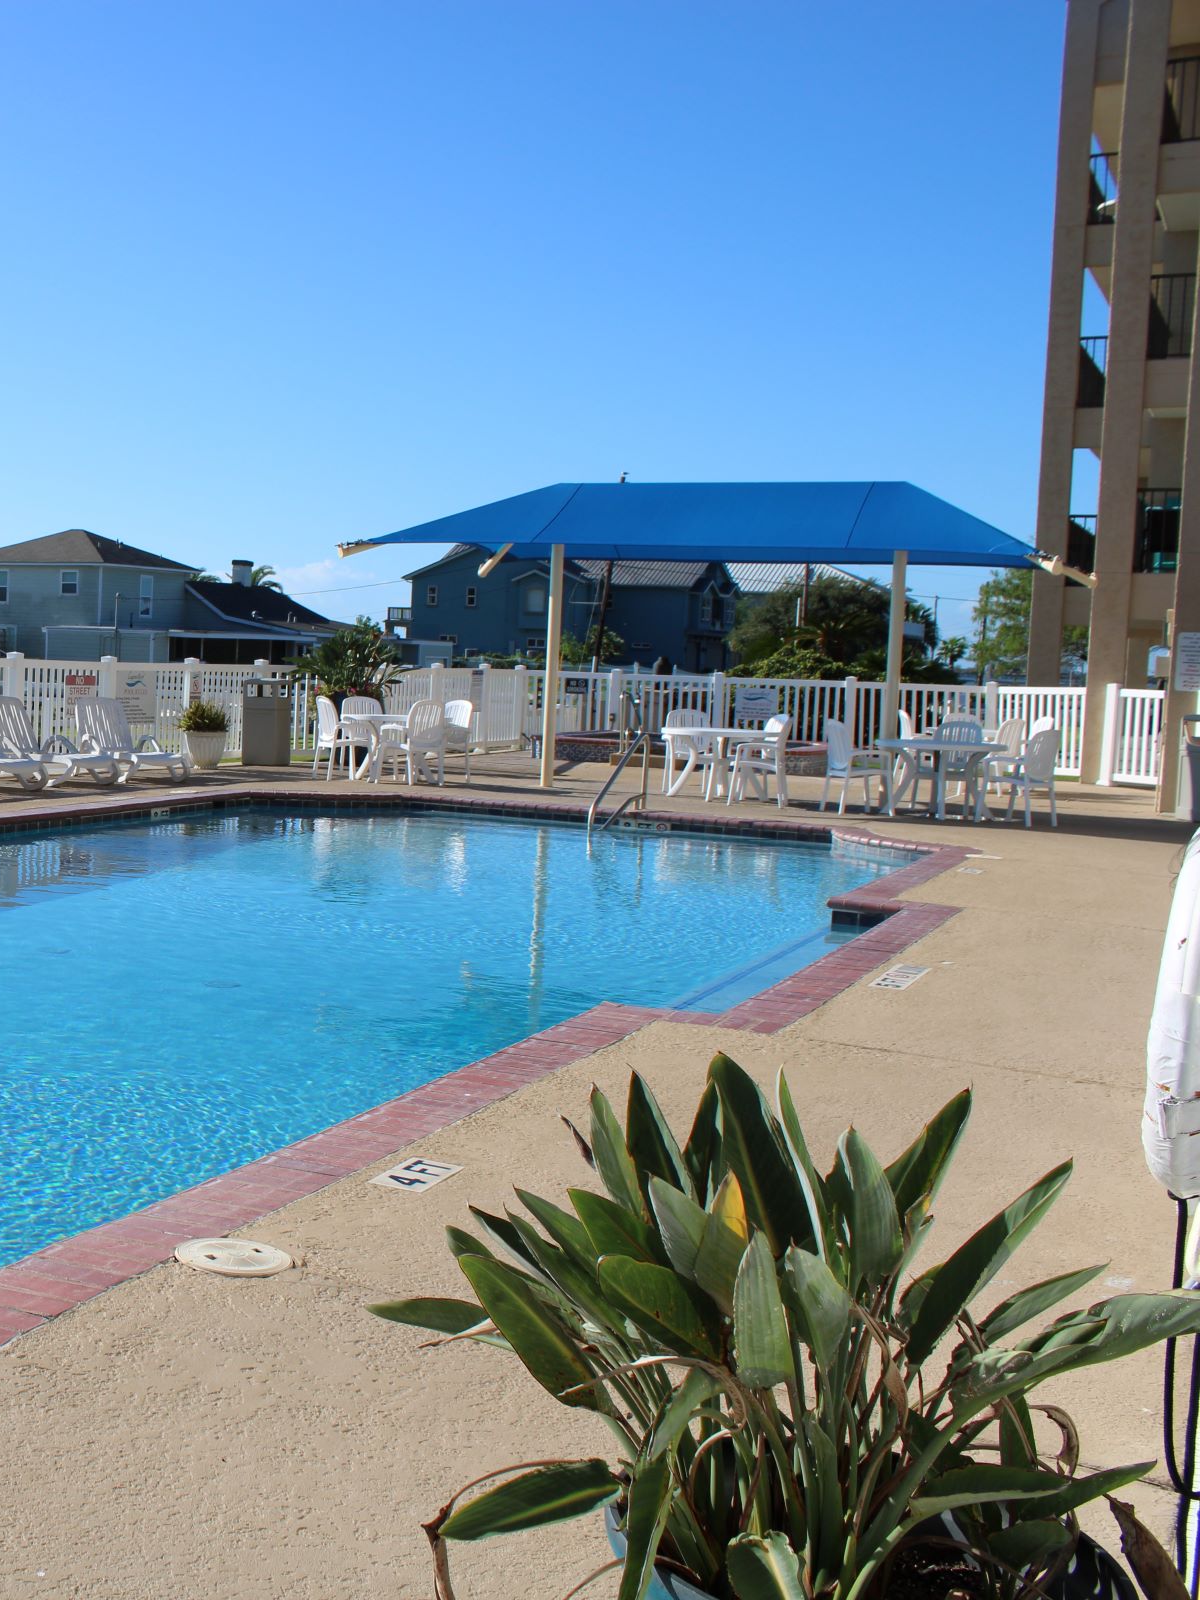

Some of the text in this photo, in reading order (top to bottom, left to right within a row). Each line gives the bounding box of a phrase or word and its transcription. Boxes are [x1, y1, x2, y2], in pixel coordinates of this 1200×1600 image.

[75, 676, 85, 685] NO
[69, 687, 90, 695] STREET
[388, 1159, 452, 1186] 4 FT
